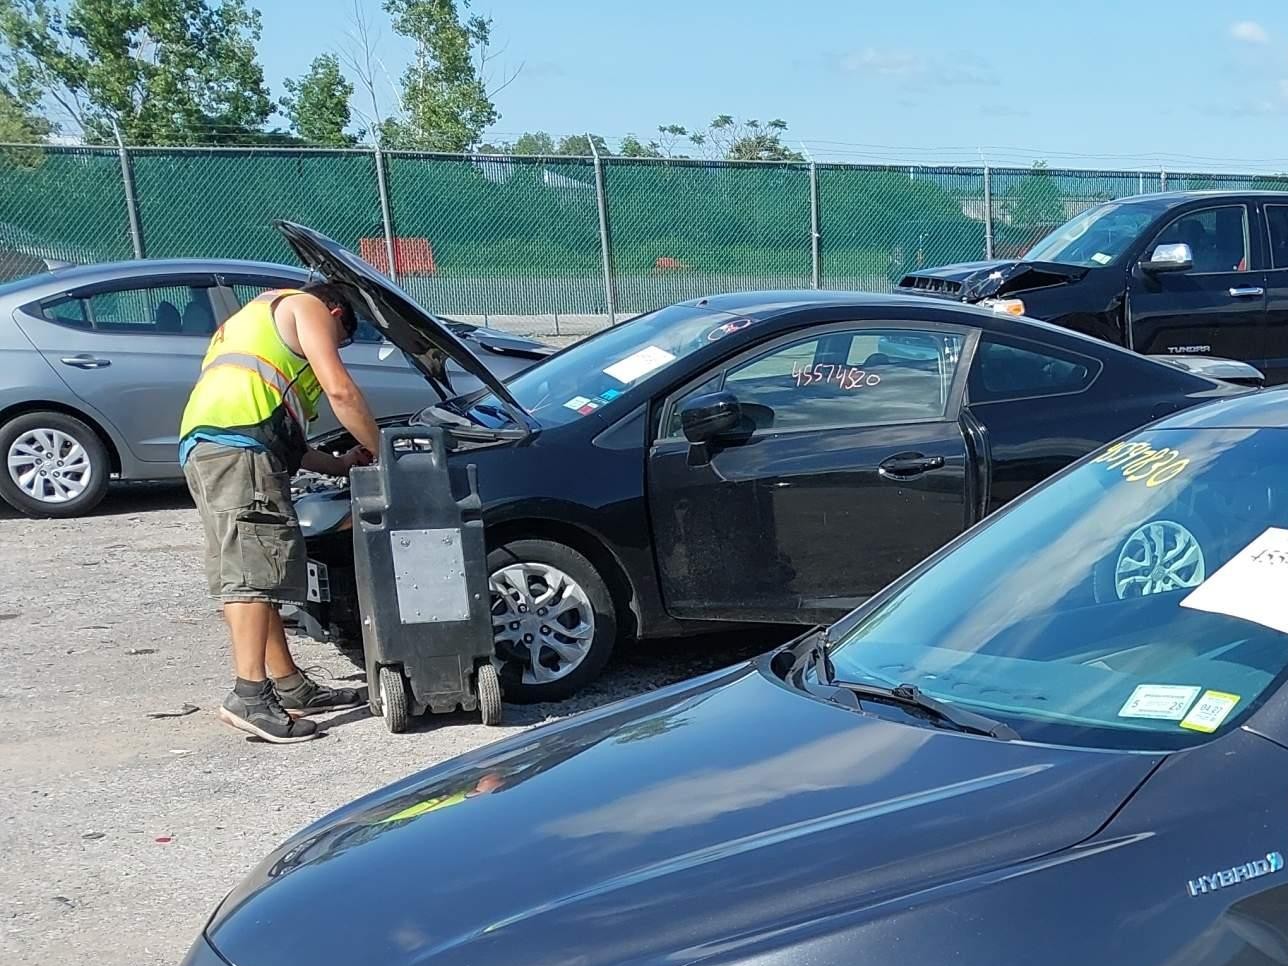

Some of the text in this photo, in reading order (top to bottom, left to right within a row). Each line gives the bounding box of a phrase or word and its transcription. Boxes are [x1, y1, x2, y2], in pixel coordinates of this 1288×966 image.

[1167, 345, 1211, 353] TUNDRA
[791, 361, 881, 390] 45574520
[1186, 858, 1271, 896] HYBRID
